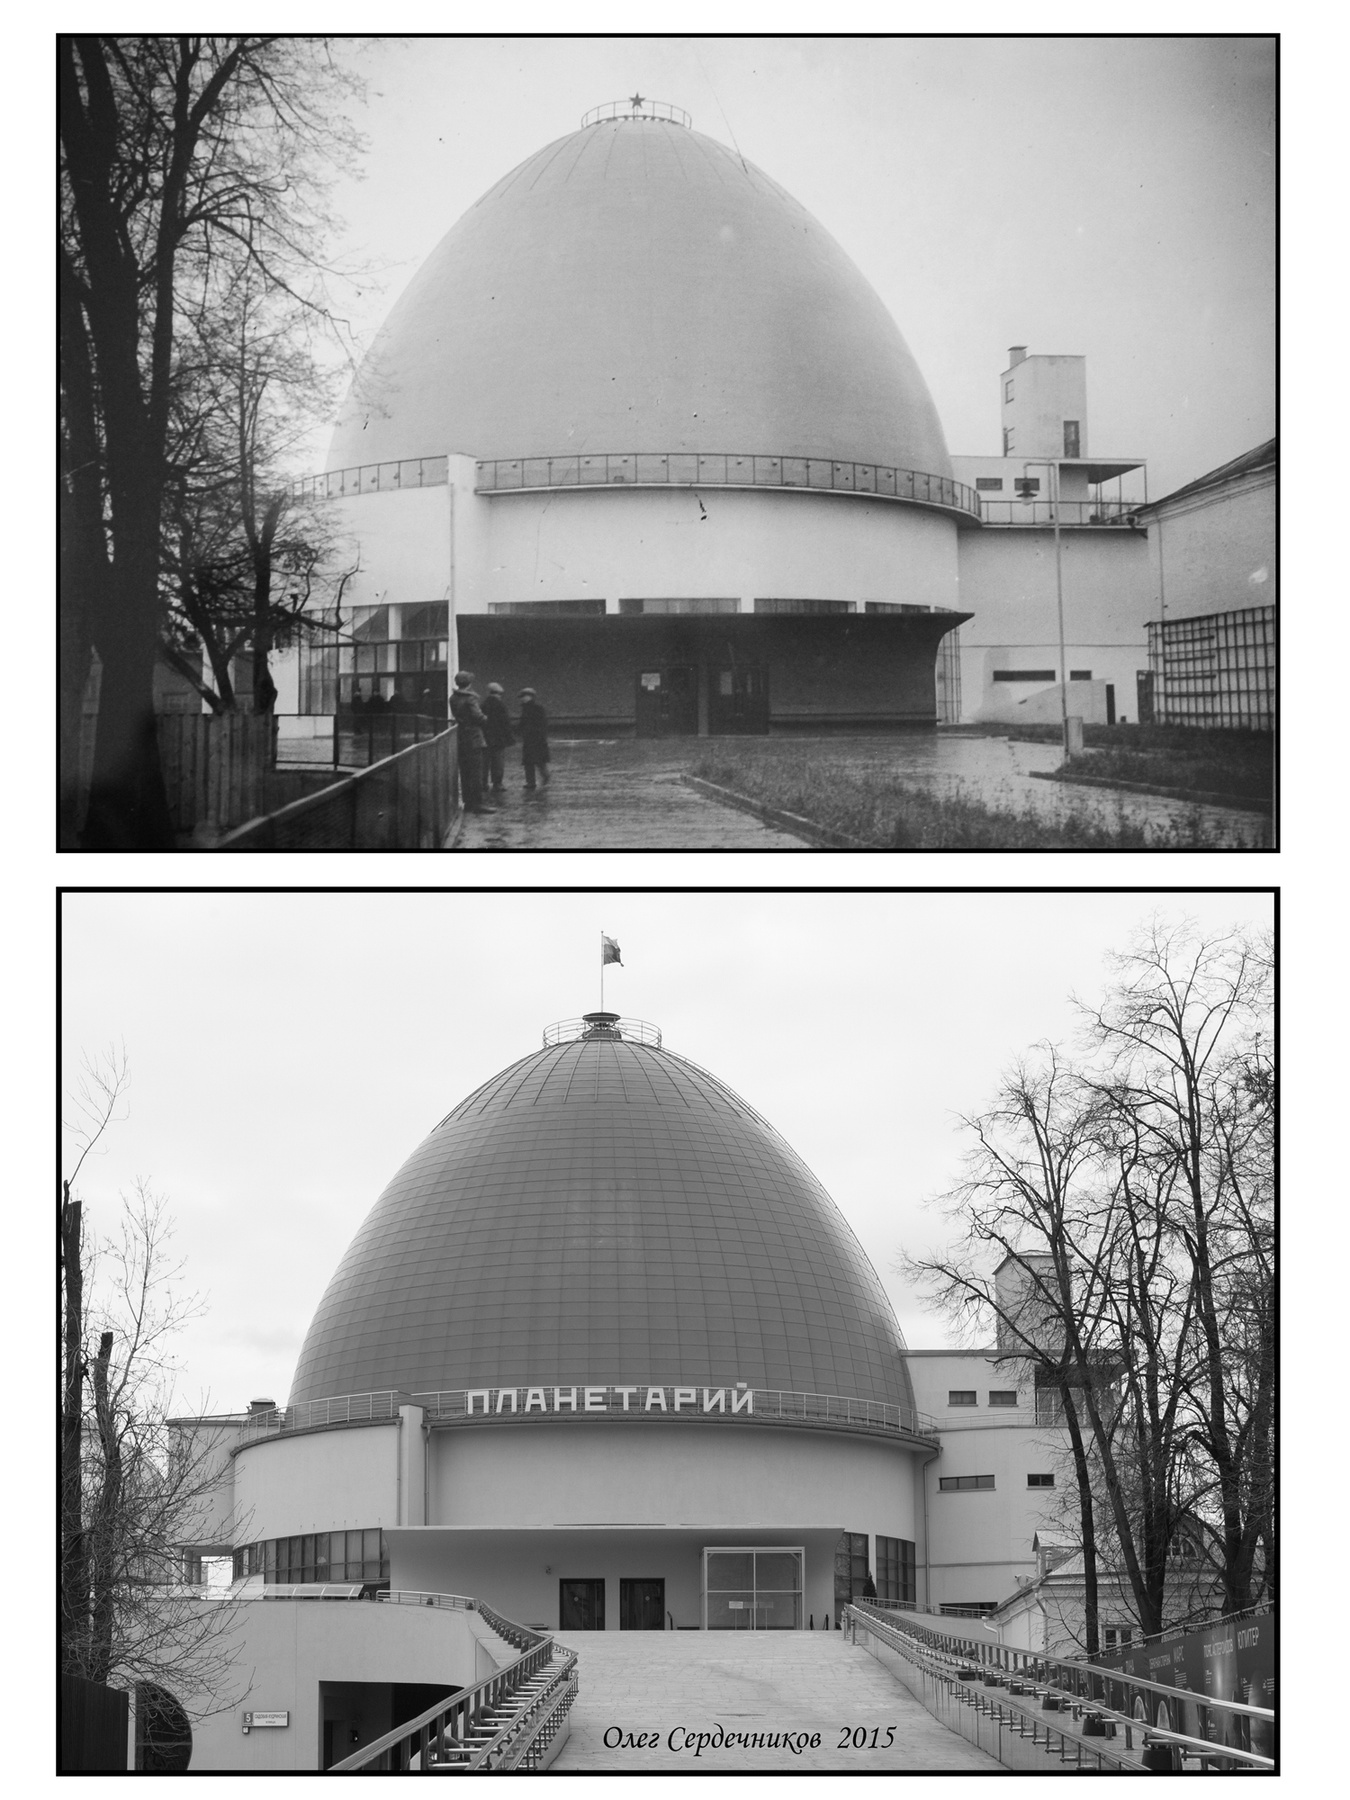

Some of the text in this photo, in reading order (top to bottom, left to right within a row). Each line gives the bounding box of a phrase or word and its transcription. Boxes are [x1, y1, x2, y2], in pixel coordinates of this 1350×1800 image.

[467, 1382, 753, 1414] ПЛАНЕТАРИЙ
[1237, 1626, 1259, 1650] ЮПИТЕР
[245, 1713, 251, 1722] 5
